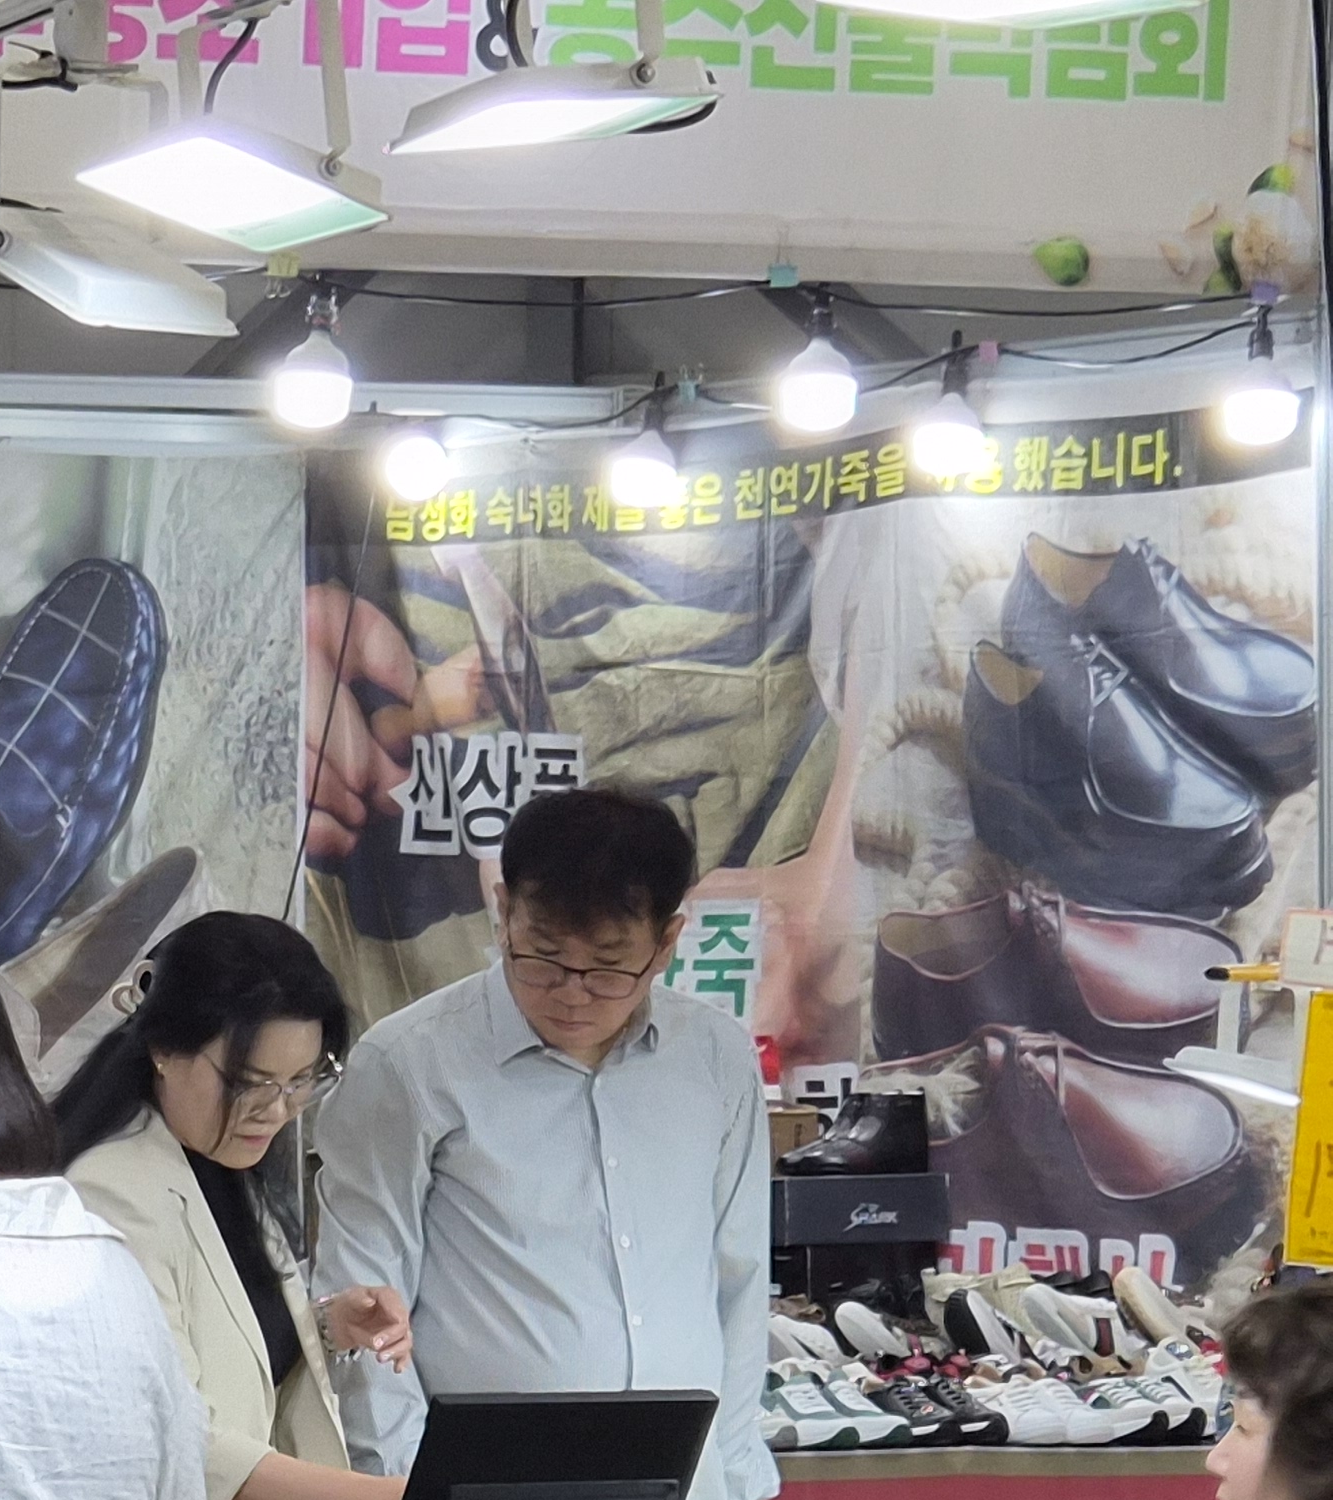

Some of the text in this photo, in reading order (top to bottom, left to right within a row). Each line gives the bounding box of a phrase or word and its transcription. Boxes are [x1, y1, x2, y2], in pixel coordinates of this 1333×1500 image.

[486, 484, 572, 534] 숙녀화
[734, 441, 907, 521] 천연가죽을
[1013, 429, 1185, 493] 했습니다.
